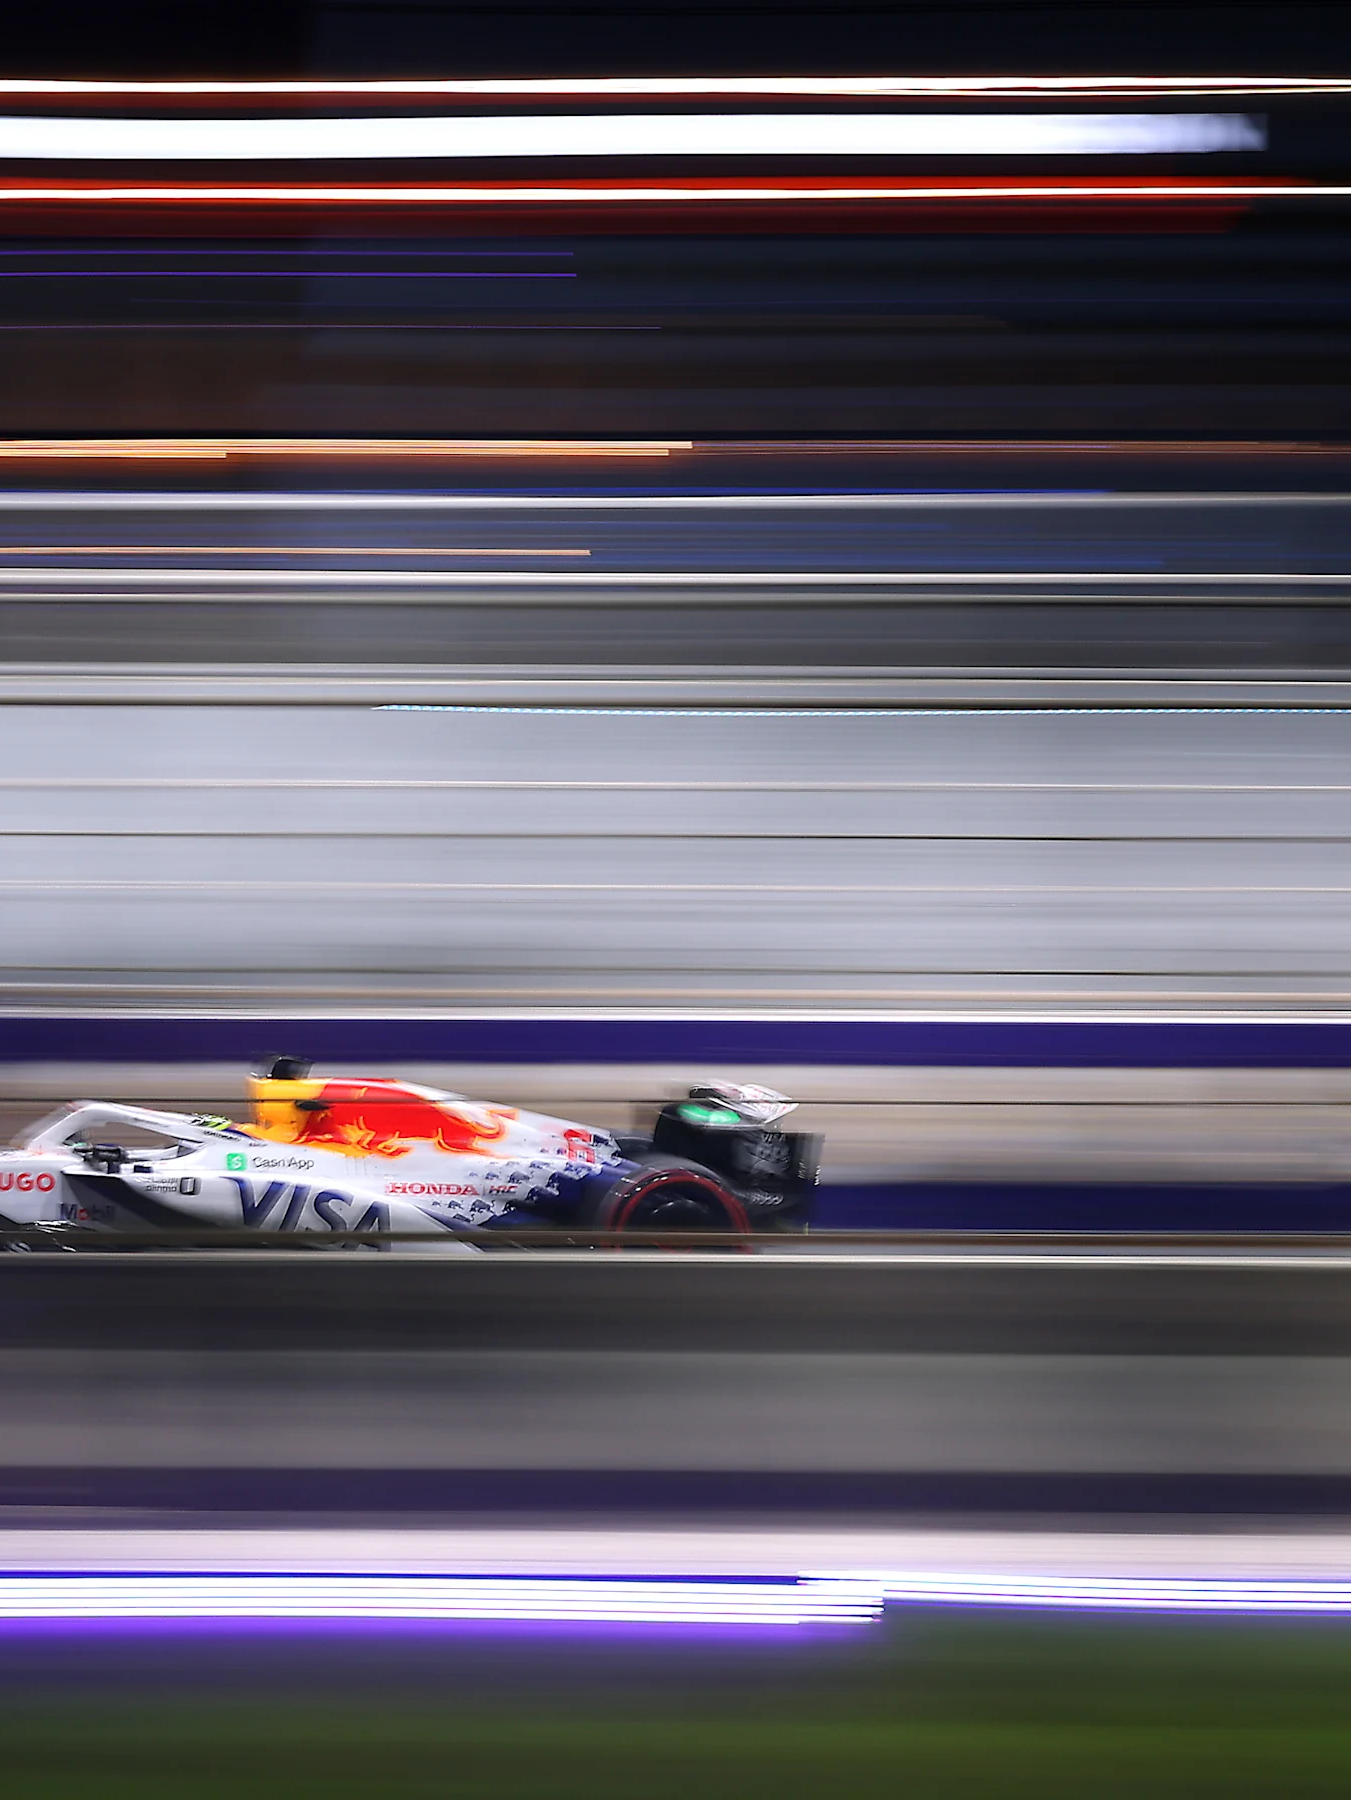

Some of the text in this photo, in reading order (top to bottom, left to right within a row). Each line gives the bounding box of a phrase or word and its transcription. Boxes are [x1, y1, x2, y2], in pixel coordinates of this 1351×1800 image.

[252, 1156, 315, 1170] Cash App
[386, 1182, 479, 1197] HONDA
[219, 1176, 391, 1252] VISA
